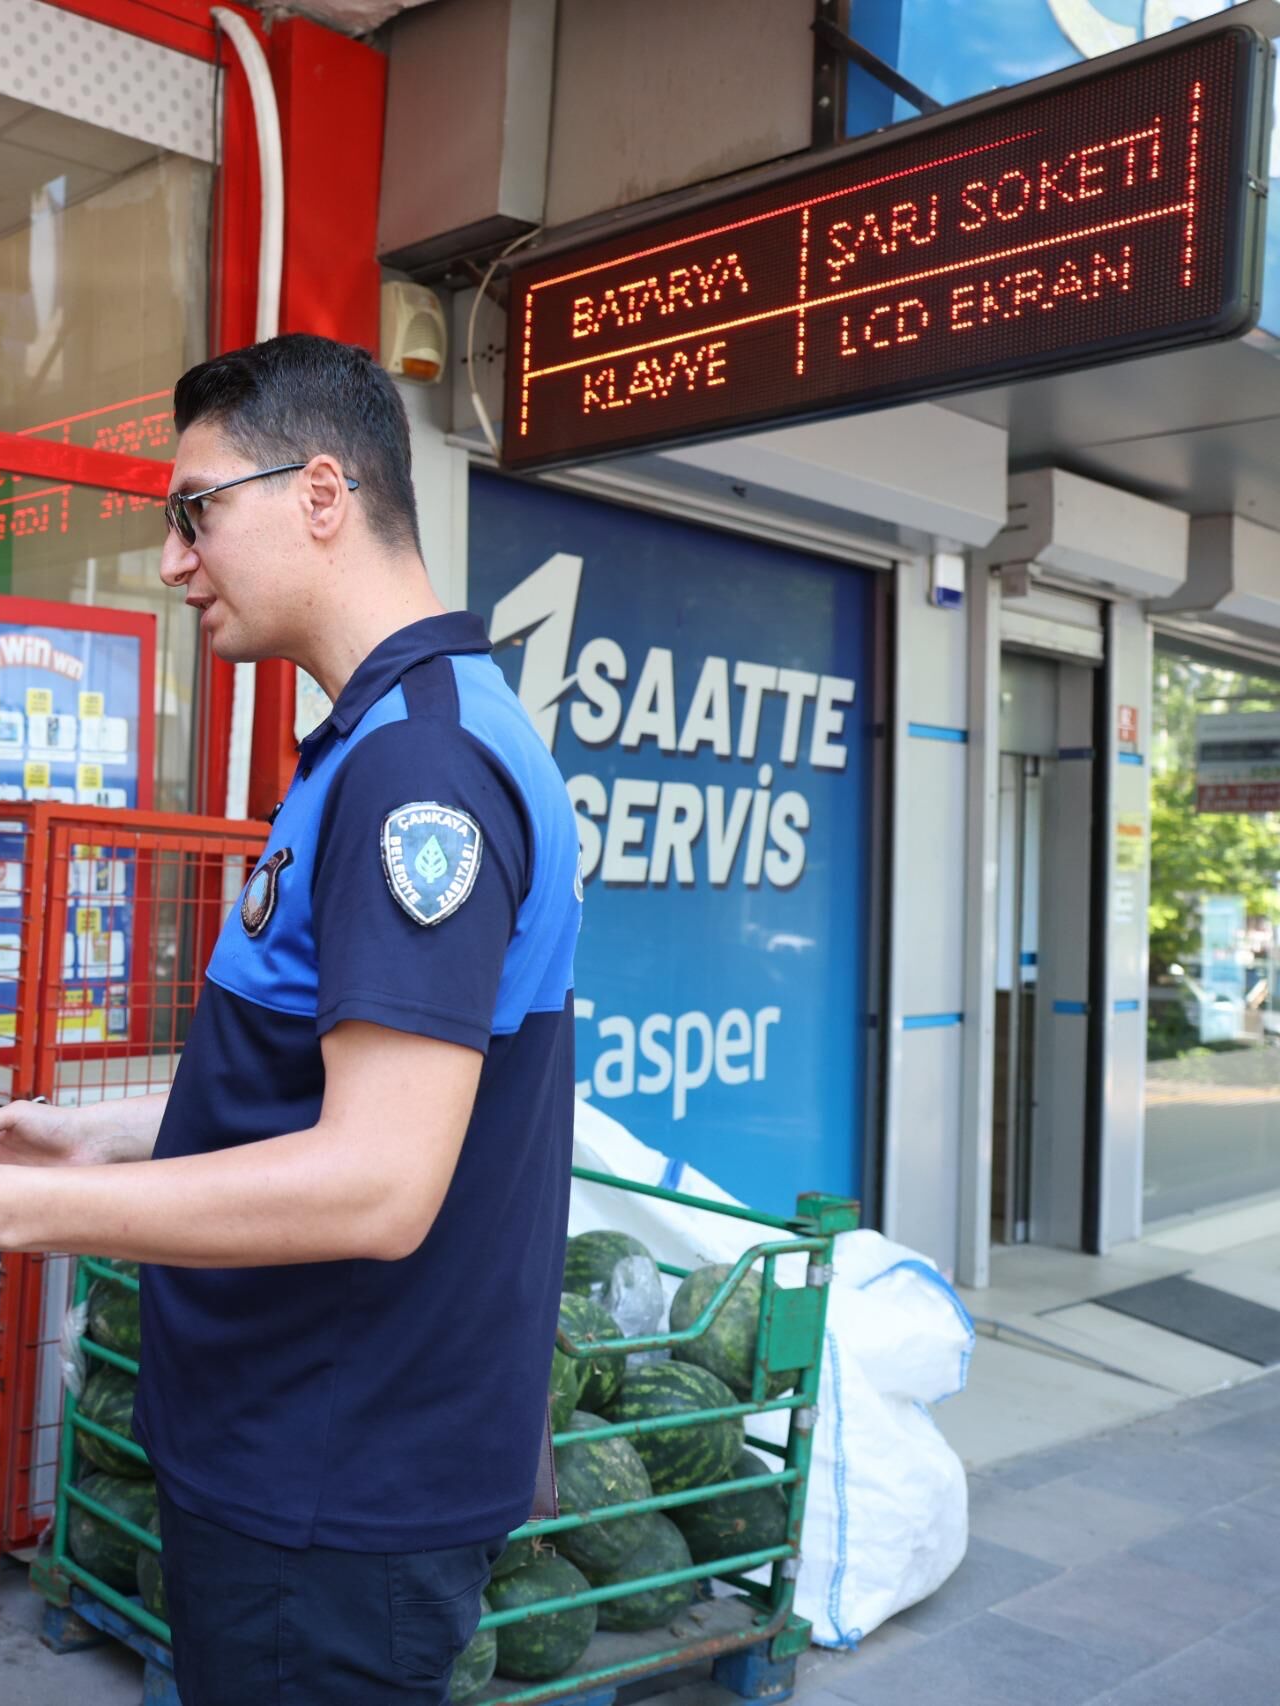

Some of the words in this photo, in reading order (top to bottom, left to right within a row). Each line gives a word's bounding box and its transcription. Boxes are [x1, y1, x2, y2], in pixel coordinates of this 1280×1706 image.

[826, 195, 939, 282] ŞARJ
[959, 115, 1161, 231] SOKETİ
[573, 253, 749, 338] BATARYA
[840, 299, 929, 356] LCD
[950, 244, 1133, 330] EKRAN
[583, 341, 726, 413] KLAVYE
[489, 552, 584, 755] 1
[571, 637, 855, 769] SAATTE
[397, 811, 469, 838] ÇANKAYA
[565, 764, 811, 888] SERVİS
